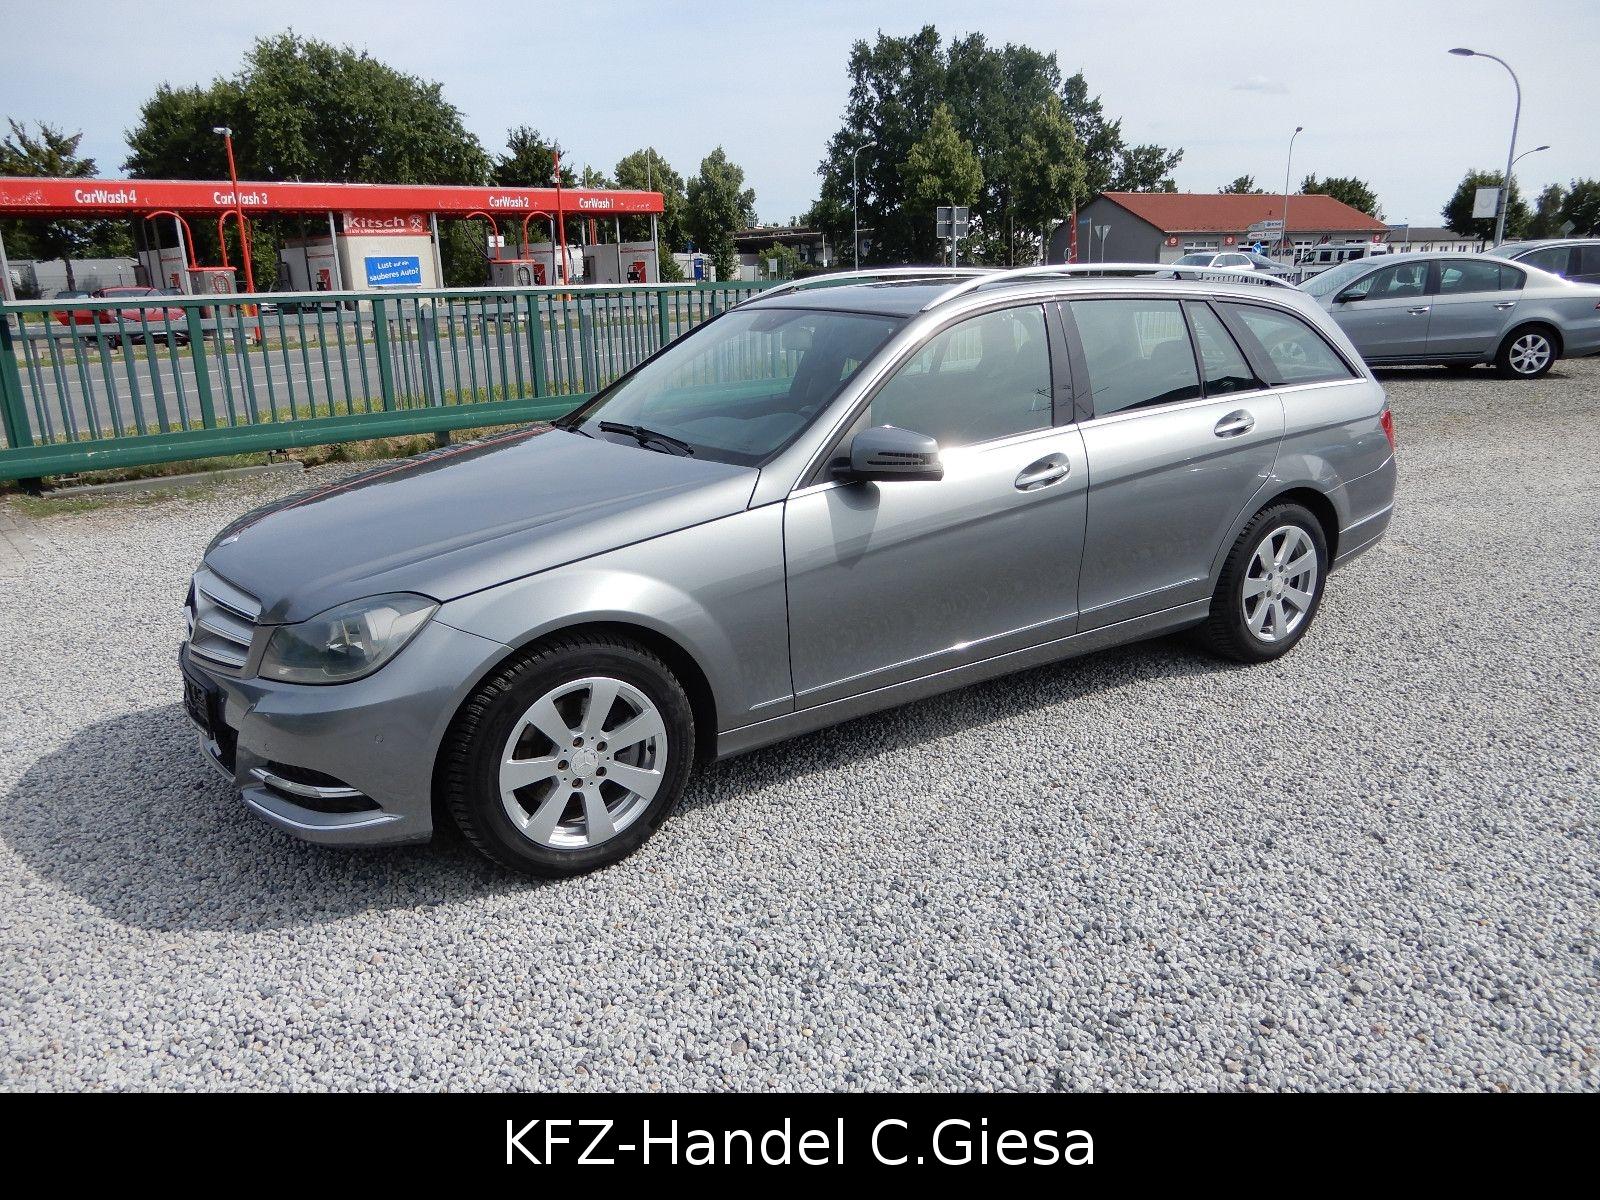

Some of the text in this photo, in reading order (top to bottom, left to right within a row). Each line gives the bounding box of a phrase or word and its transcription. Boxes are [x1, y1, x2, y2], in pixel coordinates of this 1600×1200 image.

[75, 189, 137, 204] CarWash 4
[261, 192, 268, 205] 3
[489, 196, 529, 208] CarWash 2
[579, 197, 610, 209] CarWash
[348, 216, 405, 228] Kitsch
[377, 261, 392, 270] Lust
[369, 267, 419, 282] sauberes Auto?
